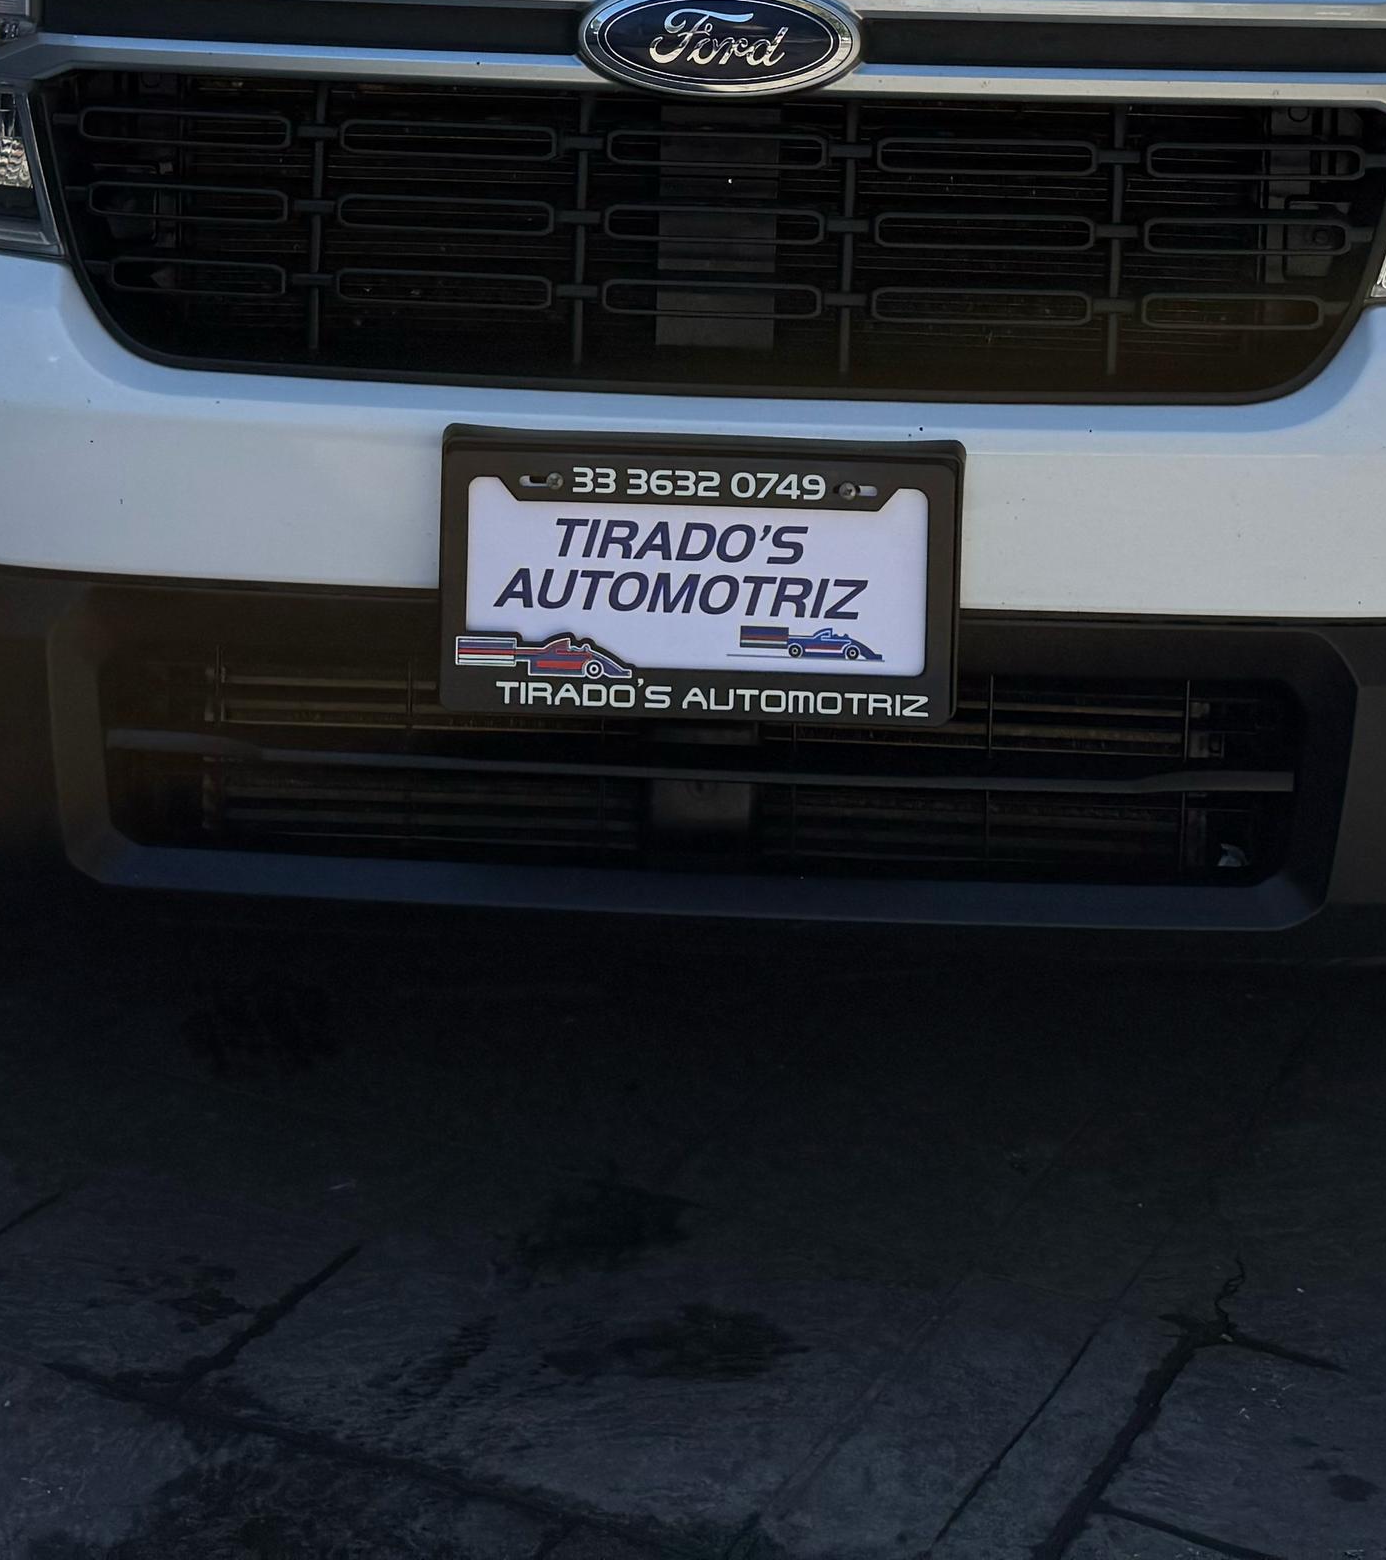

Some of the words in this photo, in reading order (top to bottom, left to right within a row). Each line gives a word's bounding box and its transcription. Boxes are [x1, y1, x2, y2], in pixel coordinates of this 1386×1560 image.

[649, 8, 789, 67] Ford
[572, 466, 616, 494] 33
[627, 469, 720, 497] 3632
[730, 472, 826, 500] 0749
[555, 517, 809, 565] TIRADO'S
[493, 567, 869, 621] AUTOMOTRIZ
[496, 677, 672, 709] TIRADO'S
[681, 687, 929, 718] AUTOMOTRIZ
